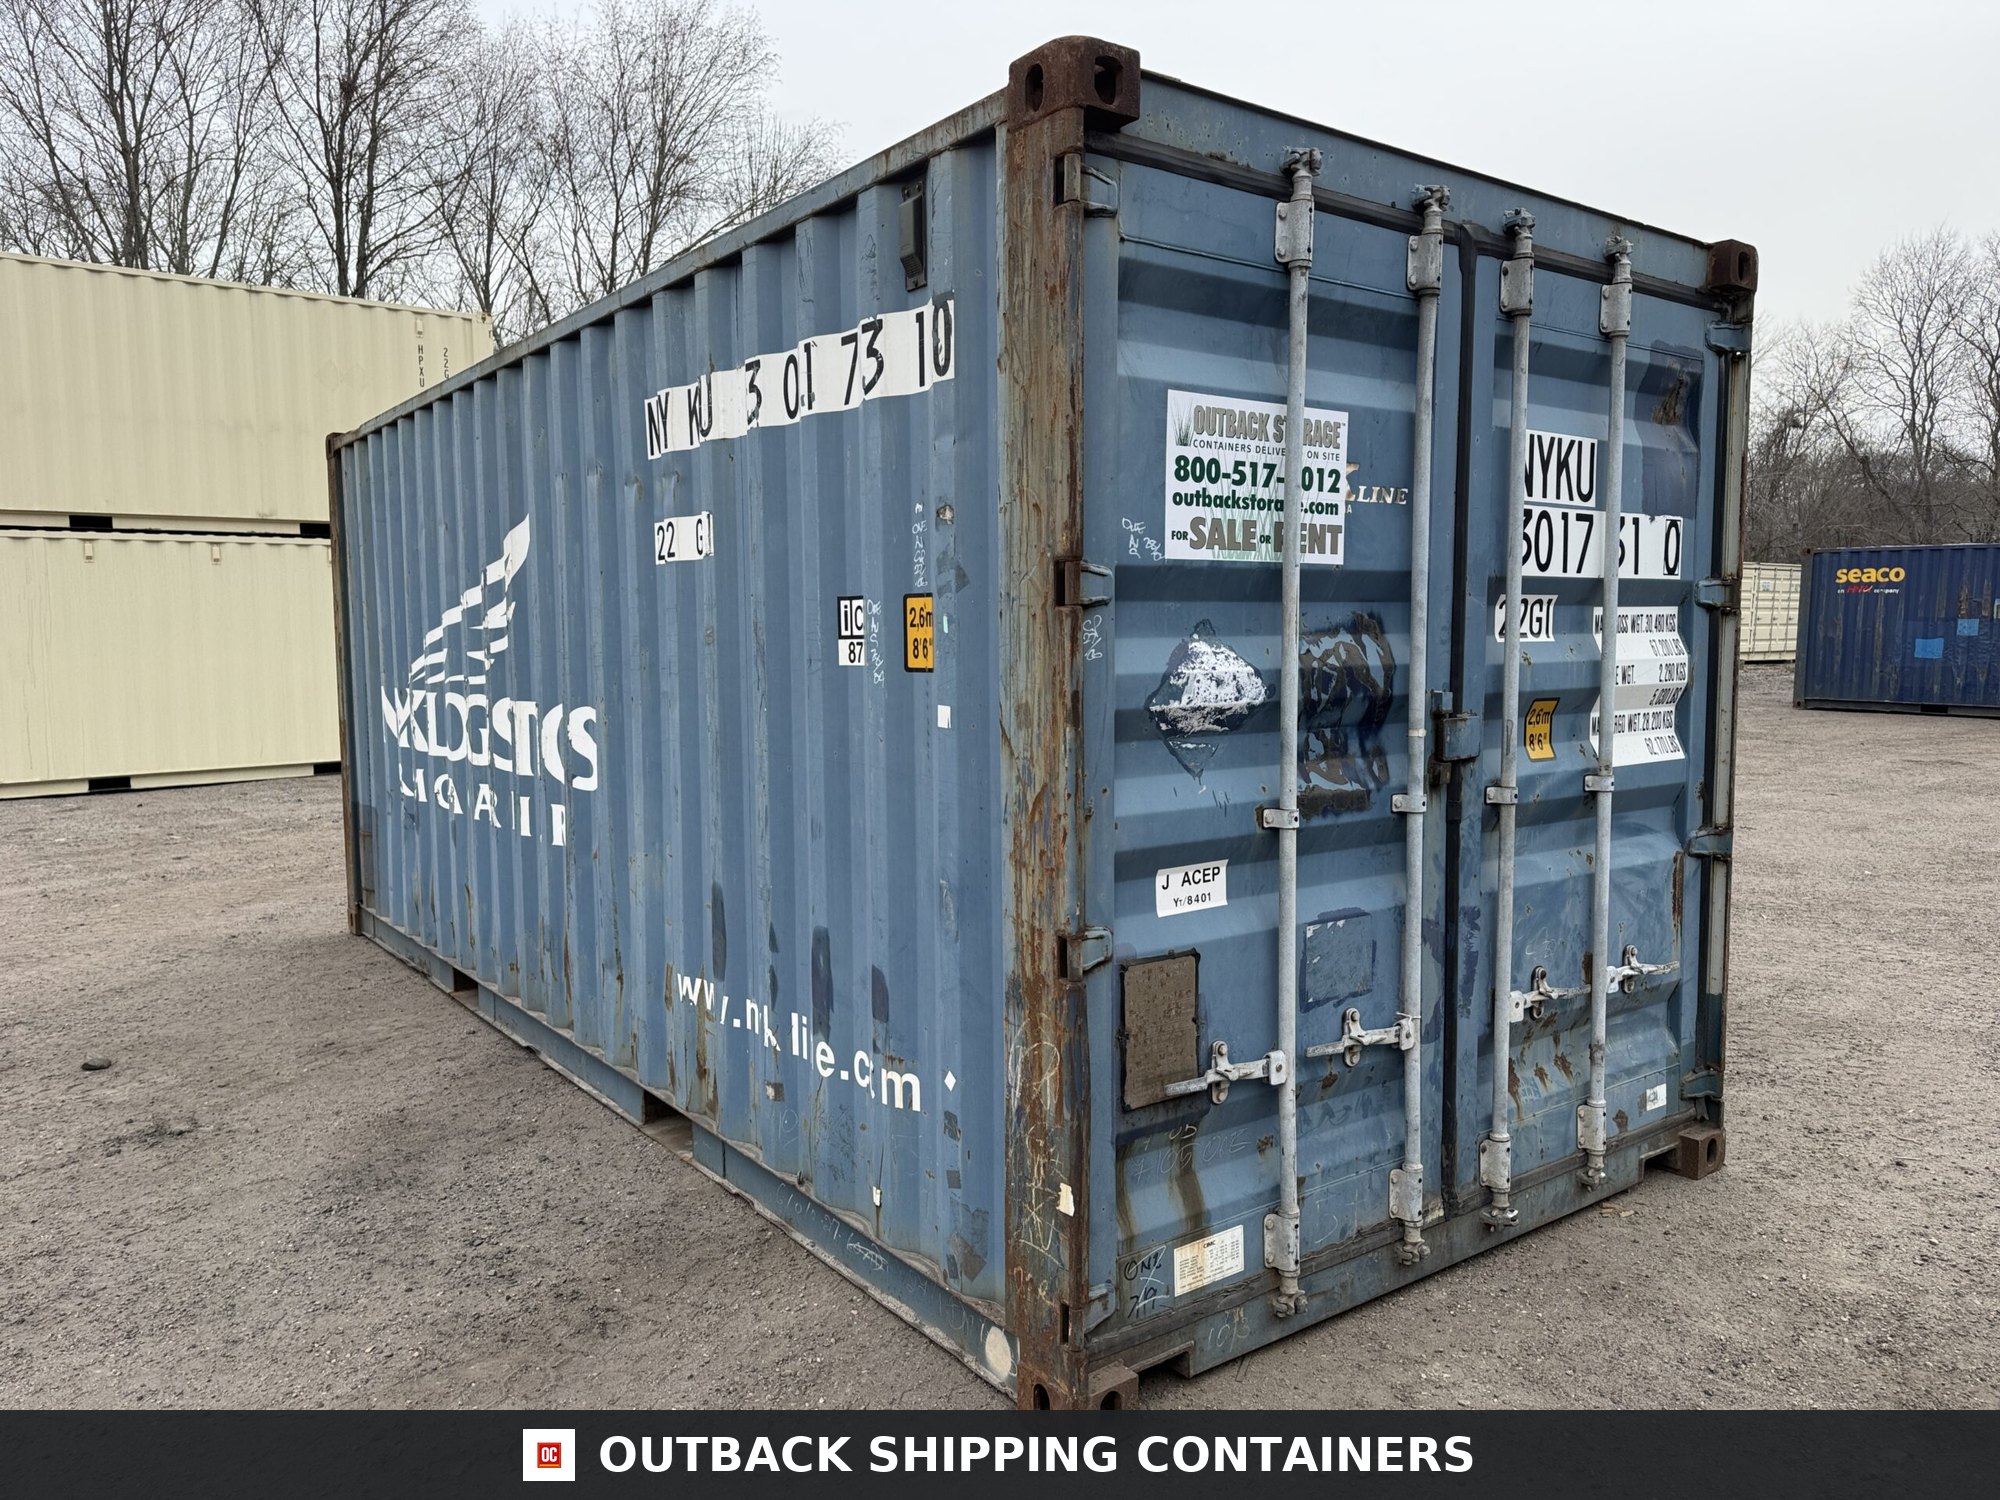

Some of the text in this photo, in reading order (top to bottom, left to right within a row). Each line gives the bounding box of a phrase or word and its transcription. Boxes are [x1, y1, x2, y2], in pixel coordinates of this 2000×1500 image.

[417, 345, 425, 388] HPXU
[1193, 405, 1341, 450] OUTBACK SRAGE
[1193, 439, 1341, 461] CONTAINERS DELIVE ON SITE
[1174, 455, 1341, 493] 800-517-012
[1172, 487, 1339, 516] outbackstora.com
[1356, 485, 1409, 505] LINE
[1171, 531, 1189, 541] FOR
[1189, 516, 1257, 552] SALE
[1259, 535, 1272, 545] OR
[1835, 567, 1906, 584] seaco
[848, 641, 864, 664] 87
[1162, 866, 1221, 890] J ACEP
